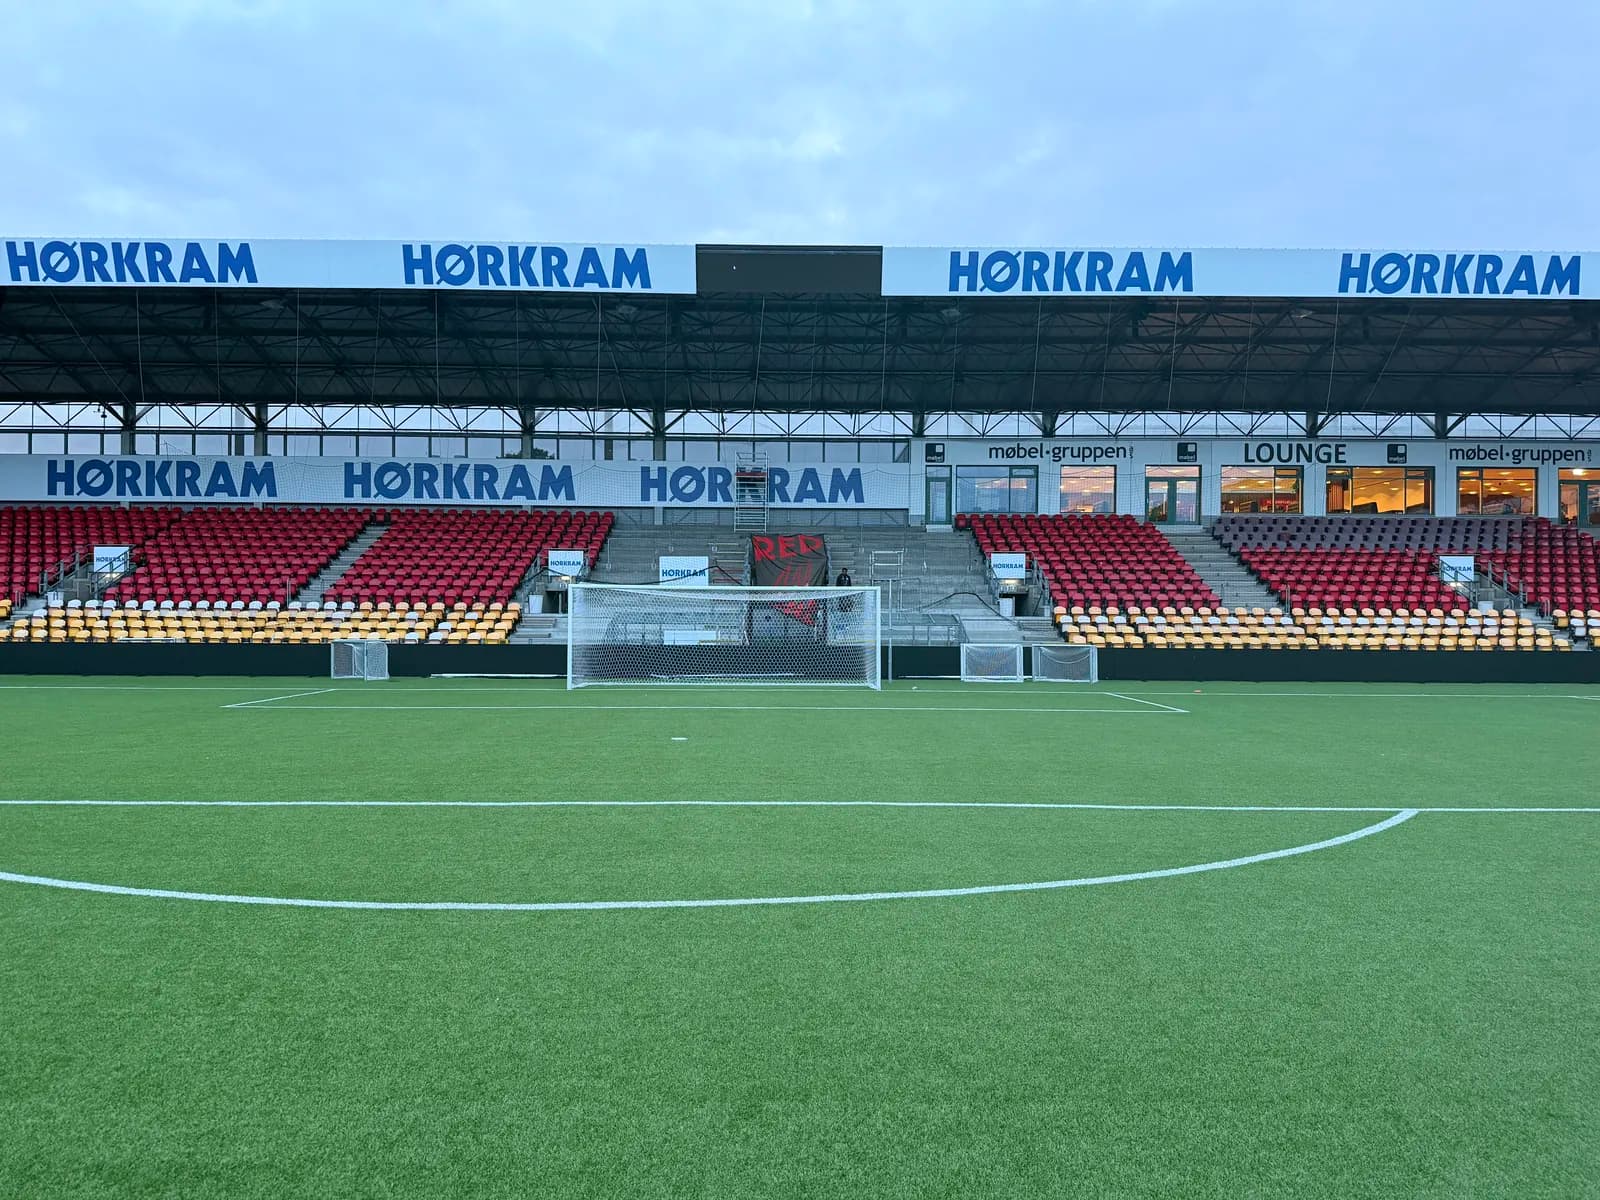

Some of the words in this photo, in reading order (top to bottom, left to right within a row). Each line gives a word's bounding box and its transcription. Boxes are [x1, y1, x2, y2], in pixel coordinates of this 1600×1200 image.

[6, 240, 258, 284] HØRKRAM
[402, 243, 652, 289] HØRKRAM
[948, 250, 1194, 293] HØRKRAM
[1338, 252, 1582, 295] HØRKRAM
[1244, 443, 1347, 464] LOUNGE
[47, 459, 277, 498] HØRKRAM
[344, 461, 576, 502] HØRKRAM
[640, 465, 865, 504] HØRRAM
